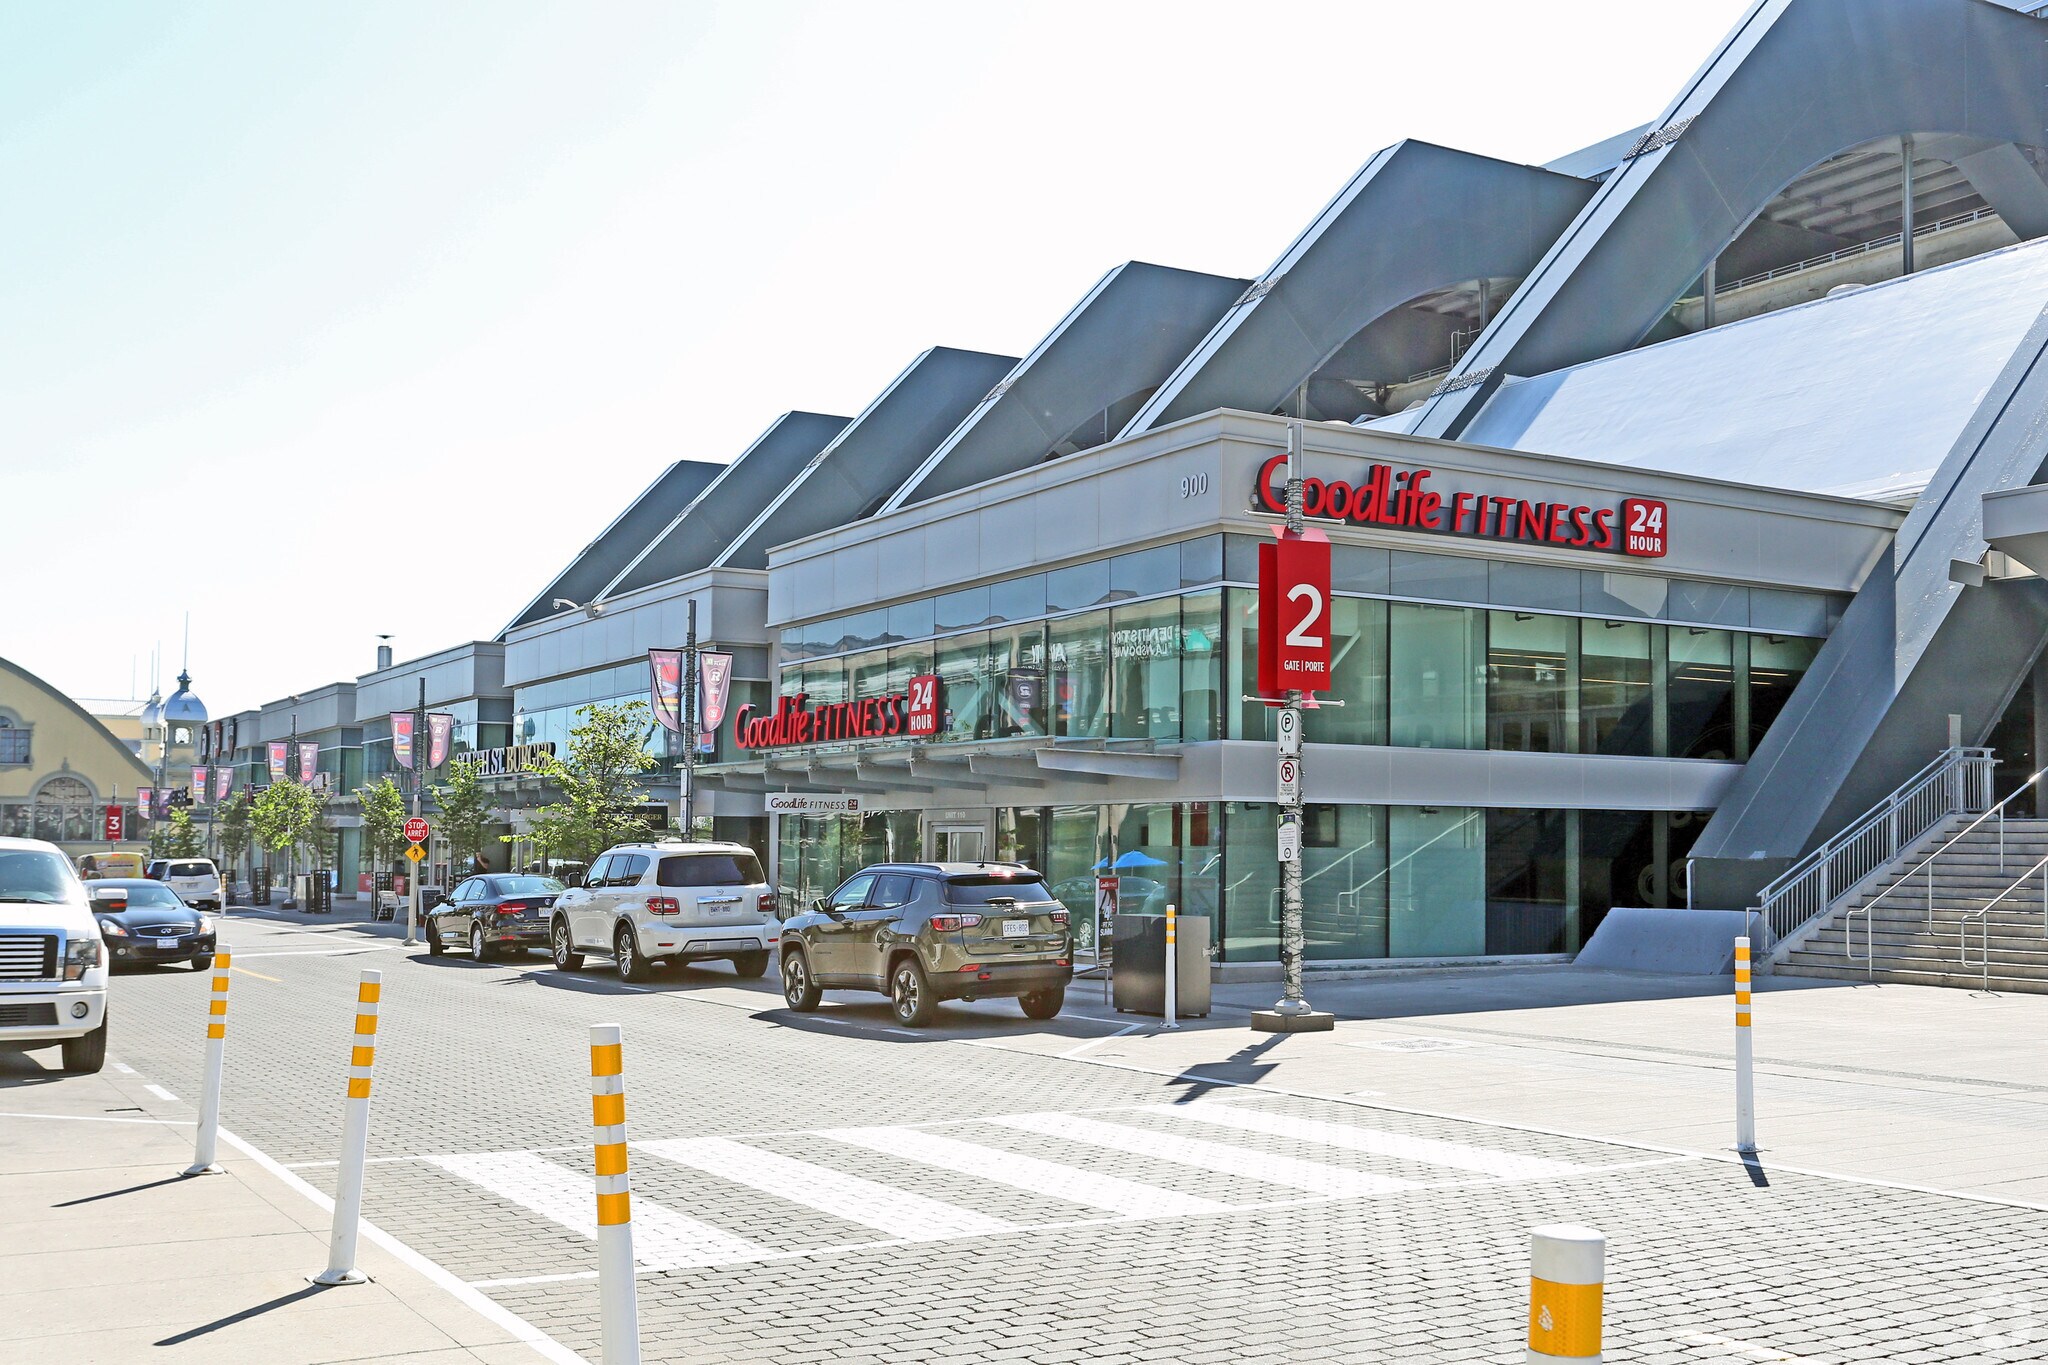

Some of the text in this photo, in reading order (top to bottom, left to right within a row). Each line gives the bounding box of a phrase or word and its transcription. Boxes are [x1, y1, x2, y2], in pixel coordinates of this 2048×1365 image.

[1181, 472, 1208, 499] 900
[1256, 454, 1614, 548] GoodLife FITNESS
[1630, 504, 1663, 534] 24
[1630, 535, 1662, 553] HOUR
[1285, 583, 1323, 648] 2
[1284, 660, 1325, 672] GATE PORTE
[911, 681, 933, 712] 24
[734, 693, 903, 748] GoodLife FITNESS
[911, 714, 932, 731] HOUR
[770, 797, 807, 809] GoodLife
[809, 800, 846, 810] FITNESS
[108, 816, 120, 830] 3
[408, 821, 426, 829] STOP
